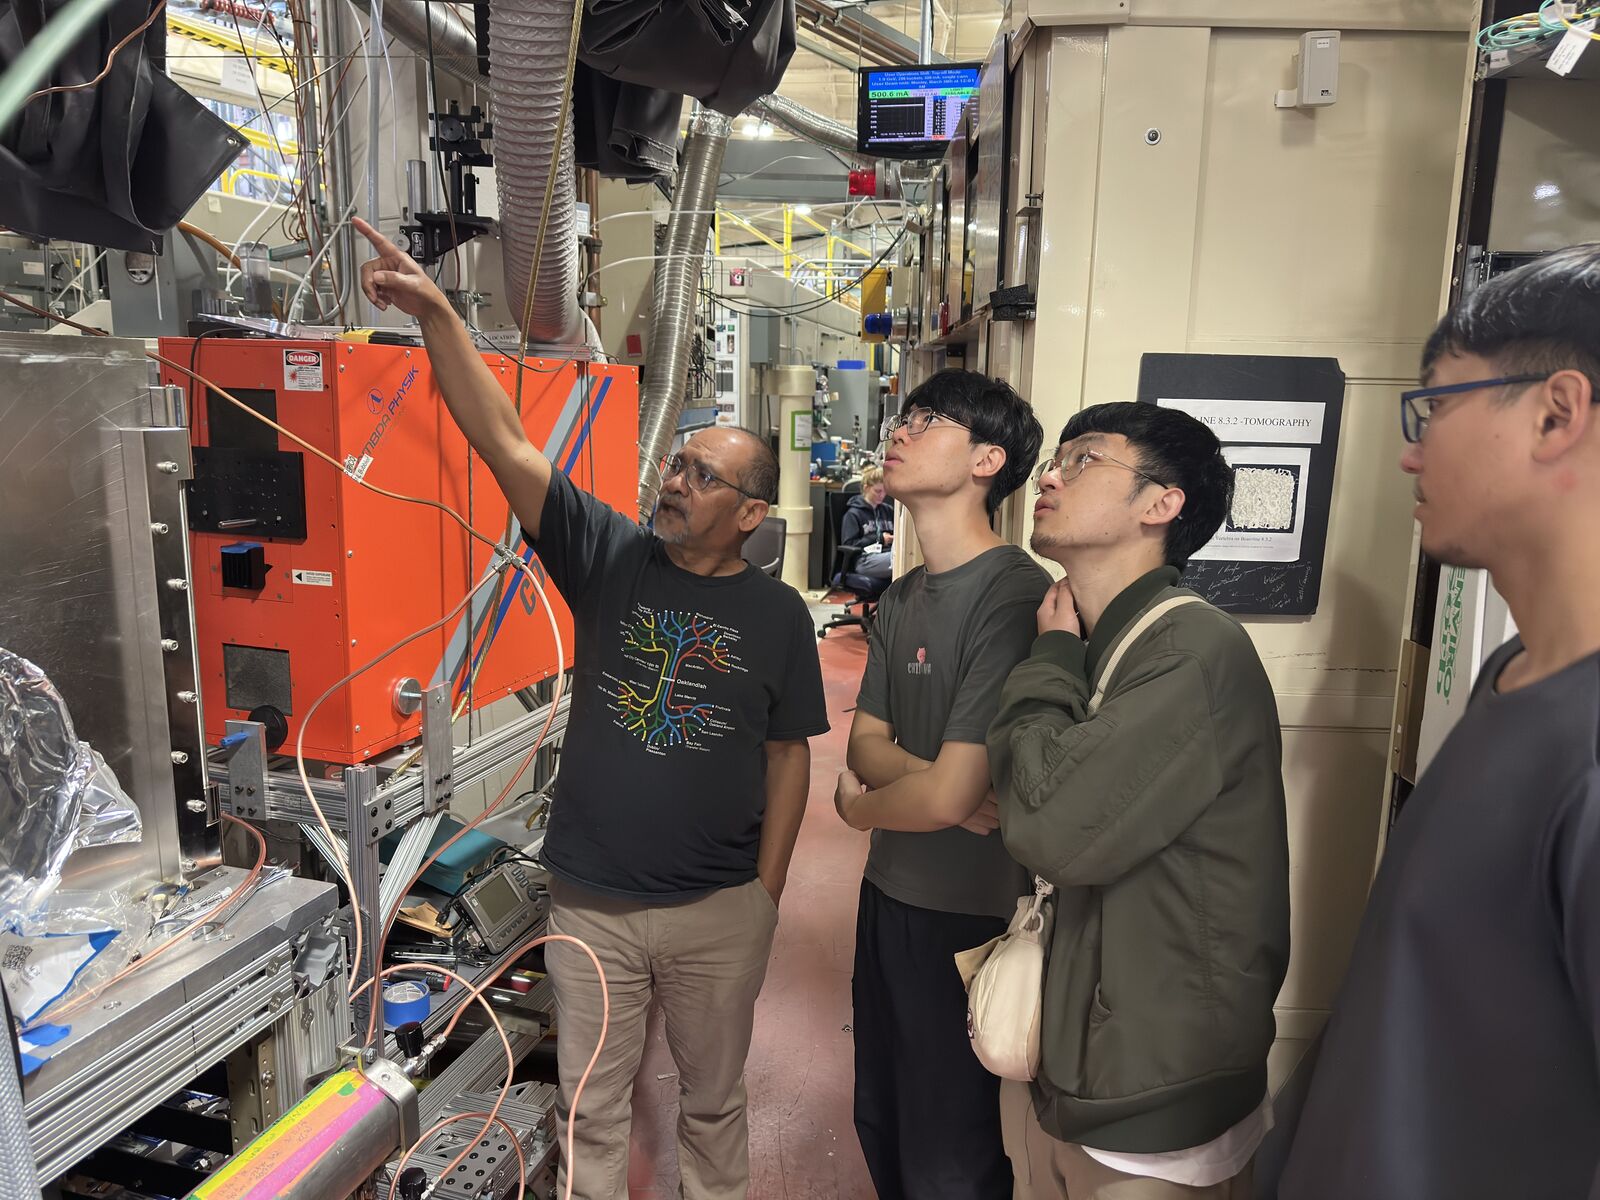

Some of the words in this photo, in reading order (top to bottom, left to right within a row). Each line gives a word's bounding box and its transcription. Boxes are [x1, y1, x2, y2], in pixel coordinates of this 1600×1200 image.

[871, 90, 894, 98] 500.6
[288, 354, 317, 363] DANGER
[387, 365, 419, 415] PHYSIK
[1217, 416, 1238, 425] 8.3.2
[676, 678, 707, 690] Oaklandish
